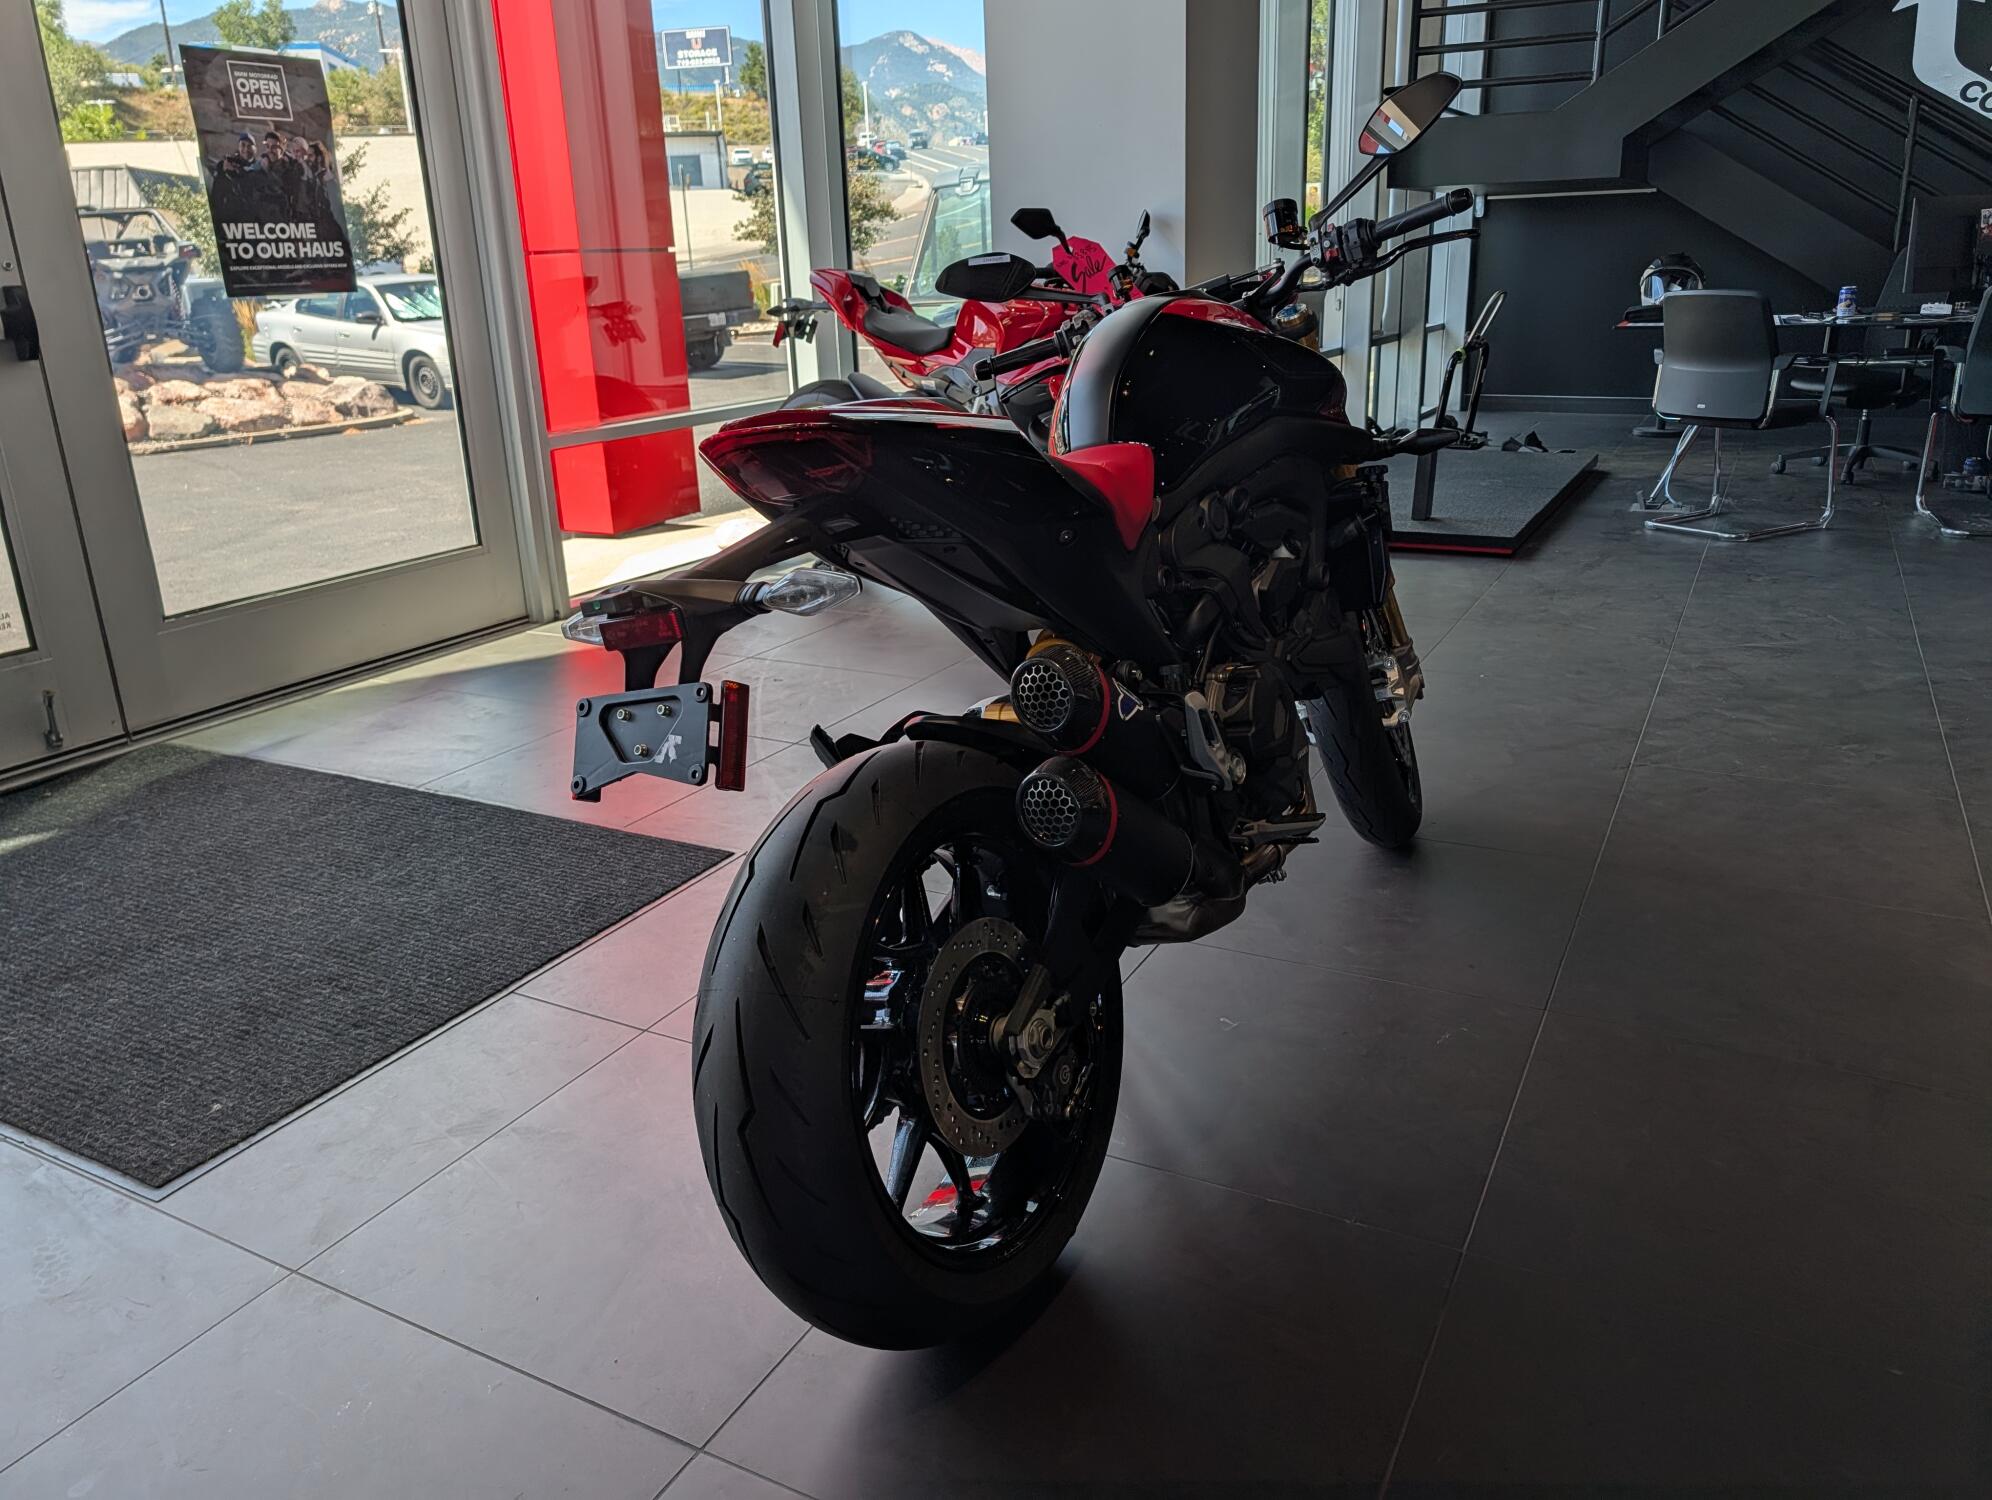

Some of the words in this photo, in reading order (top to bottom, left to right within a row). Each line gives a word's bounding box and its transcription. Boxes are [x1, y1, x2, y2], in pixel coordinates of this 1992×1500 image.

[677, 48, 718, 59] STORAGE
[248, 72, 279, 80] MOTORRAD
[236, 77, 282, 95] OPEN
[239, 93, 284, 110] HAUS
[222, 222, 317, 239] WELCOME
[226, 242, 254, 259] TO
[256, 242, 297, 259] OUR
[298, 241, 345, 258] HAUS
[1071, 255, 1107, 293] Sale
